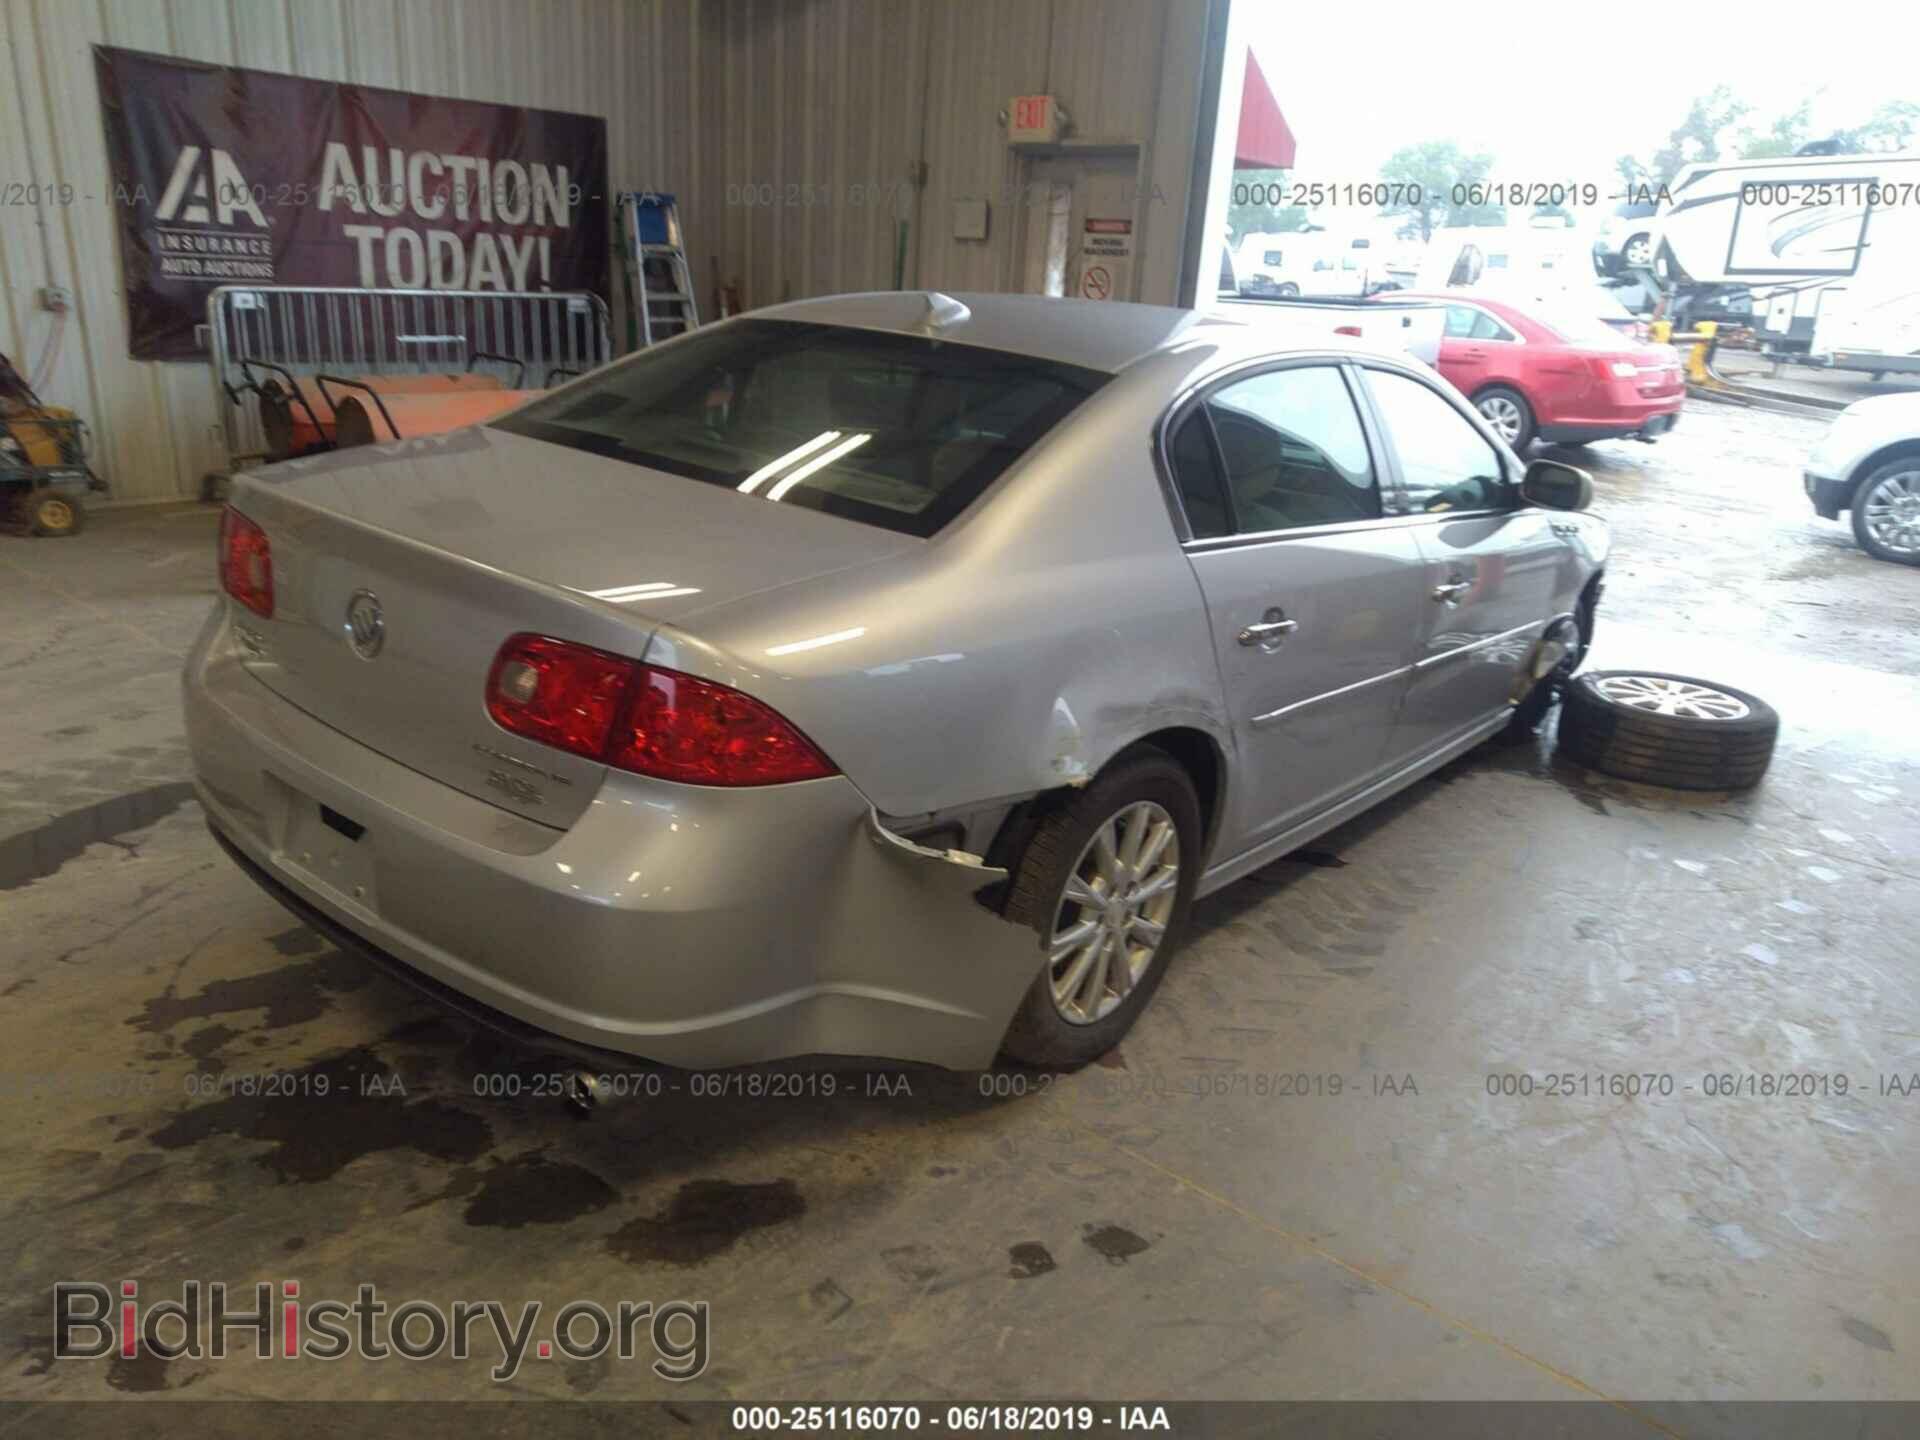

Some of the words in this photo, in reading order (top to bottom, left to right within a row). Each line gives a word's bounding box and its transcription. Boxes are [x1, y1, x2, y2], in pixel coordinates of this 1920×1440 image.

[1015, 98, 1049, 129] EXIT
[317, 141, 571, 228] AUCTION
[159, 233, 272, 256] INSURANCE
[342, 223, 551, 293] TODAY!
[161, 257, 203, 275] AUTO
[203, 259, 274, 278] AUCTIONS
